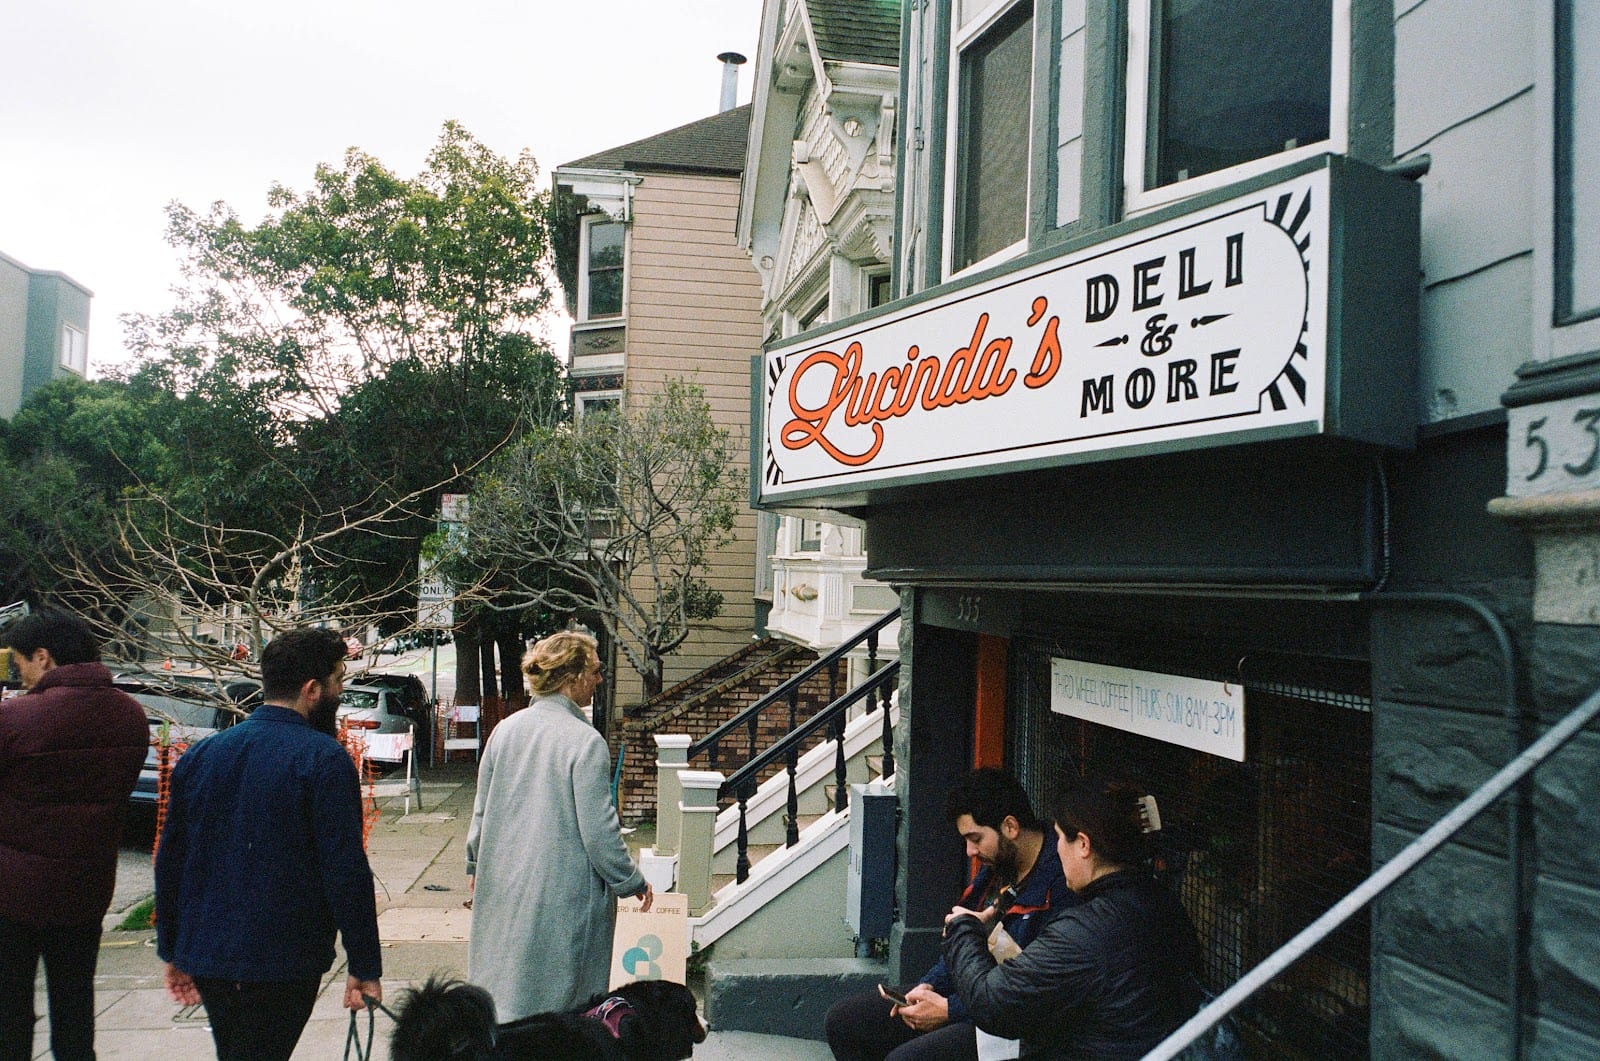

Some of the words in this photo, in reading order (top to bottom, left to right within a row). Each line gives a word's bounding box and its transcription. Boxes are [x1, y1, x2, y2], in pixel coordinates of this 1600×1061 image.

[1086, 232, 1244, 323] DELI
[1140, 313, 1176, 357] &
[780, 296, 1062, 465] Lucinda's
[1080, 347, 1242, 419] MORE
[423, 586, 449, 595] ONLY
[1101, 680, 1129, 712] COFFEE
